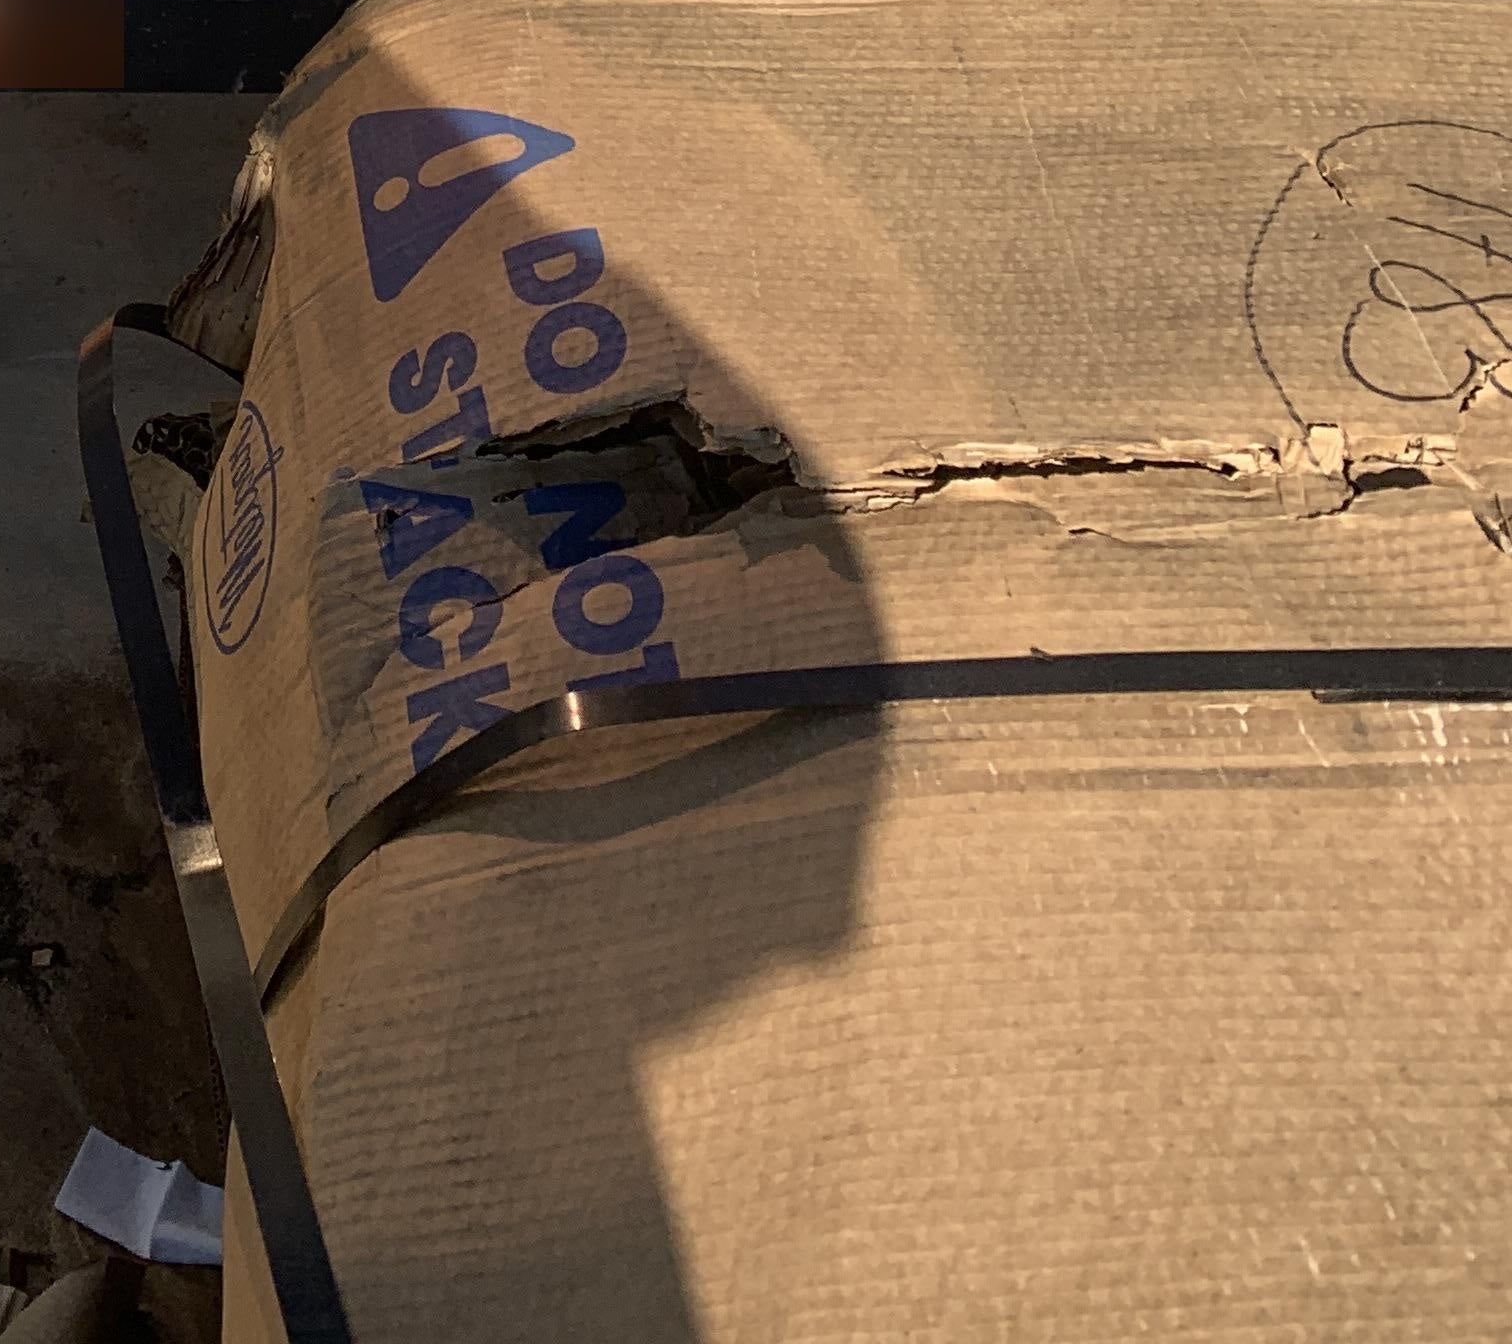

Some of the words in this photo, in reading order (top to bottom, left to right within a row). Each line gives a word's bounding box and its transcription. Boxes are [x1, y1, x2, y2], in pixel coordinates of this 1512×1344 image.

[502, 227, 628, 395] DO
[359, 331, 518, 775] STACK
[523, 480, 681, 692] NOT
